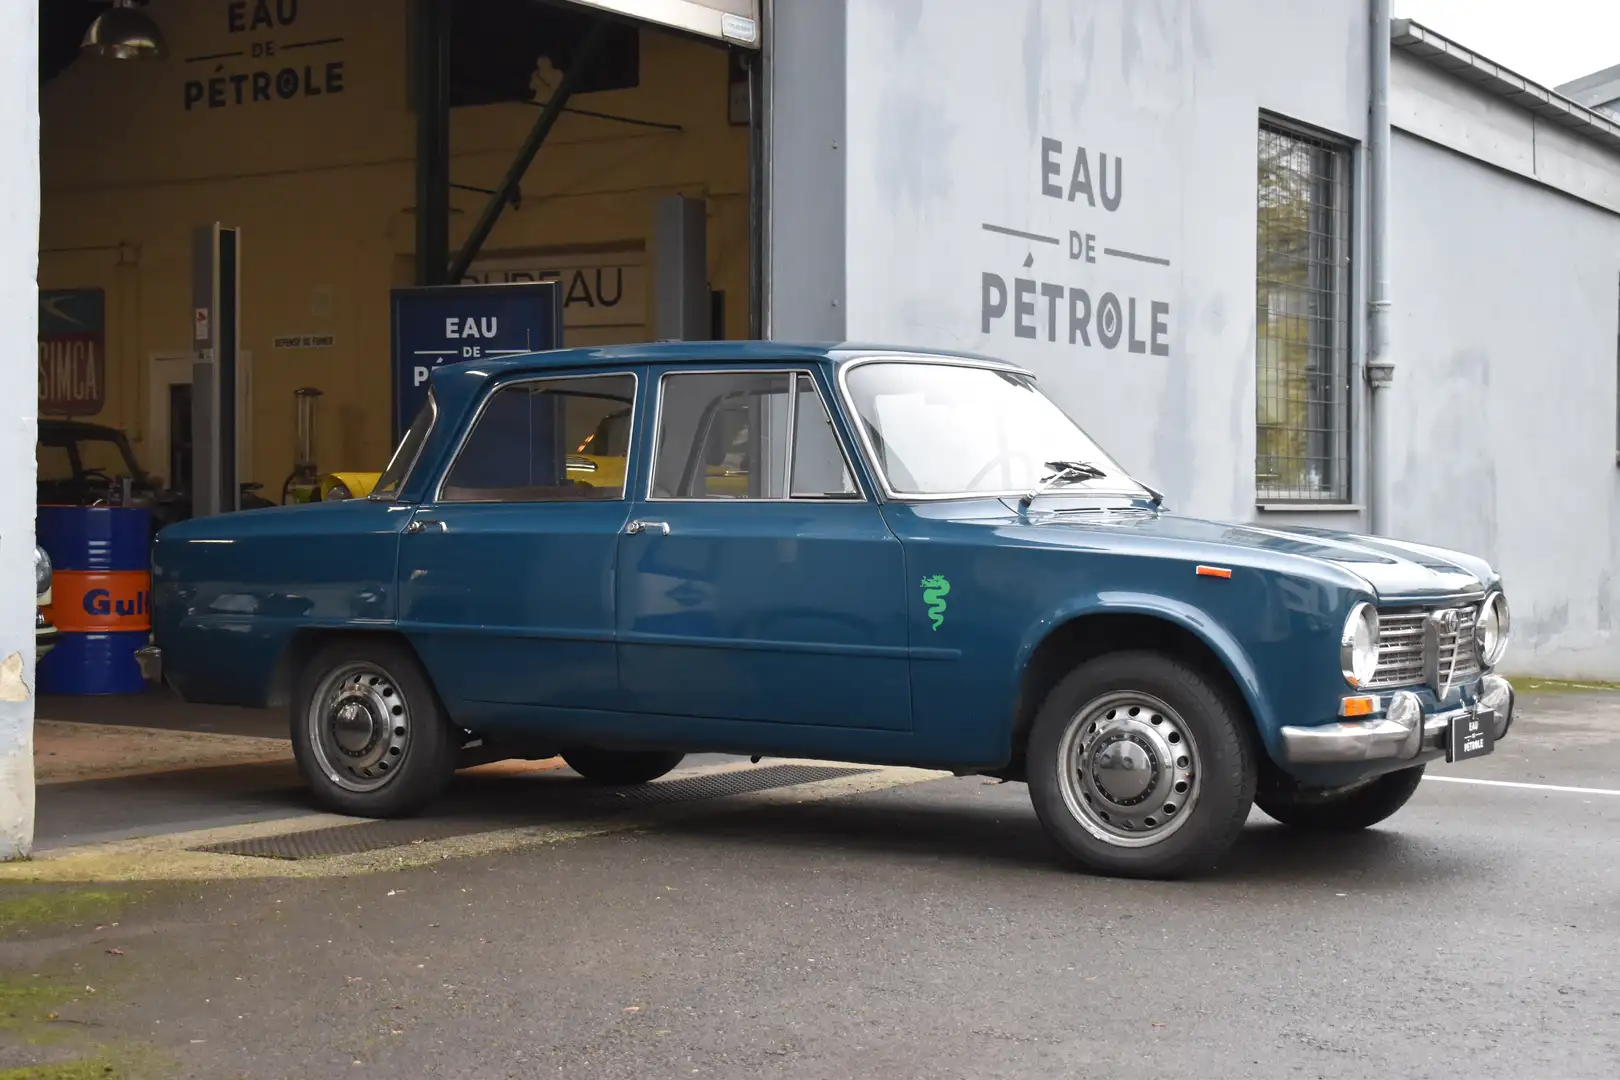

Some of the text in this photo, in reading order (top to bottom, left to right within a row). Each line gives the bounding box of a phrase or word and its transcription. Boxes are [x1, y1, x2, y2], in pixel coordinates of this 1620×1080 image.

[228, 0, 298, 33] EAU
[251, 40, 276, 58] DE
[184, 61, 344, 111] PÉTROLE
[1041, 136, 1122, 212] EAU
[1069, 230, 1096, 264] DE
[981, 252, 1169, 356] PÉTROLE
[445, 316, 498, 339] EAU
[462, 346, 481, 358] DE
[38, 340, 98, 402] SIMCA
